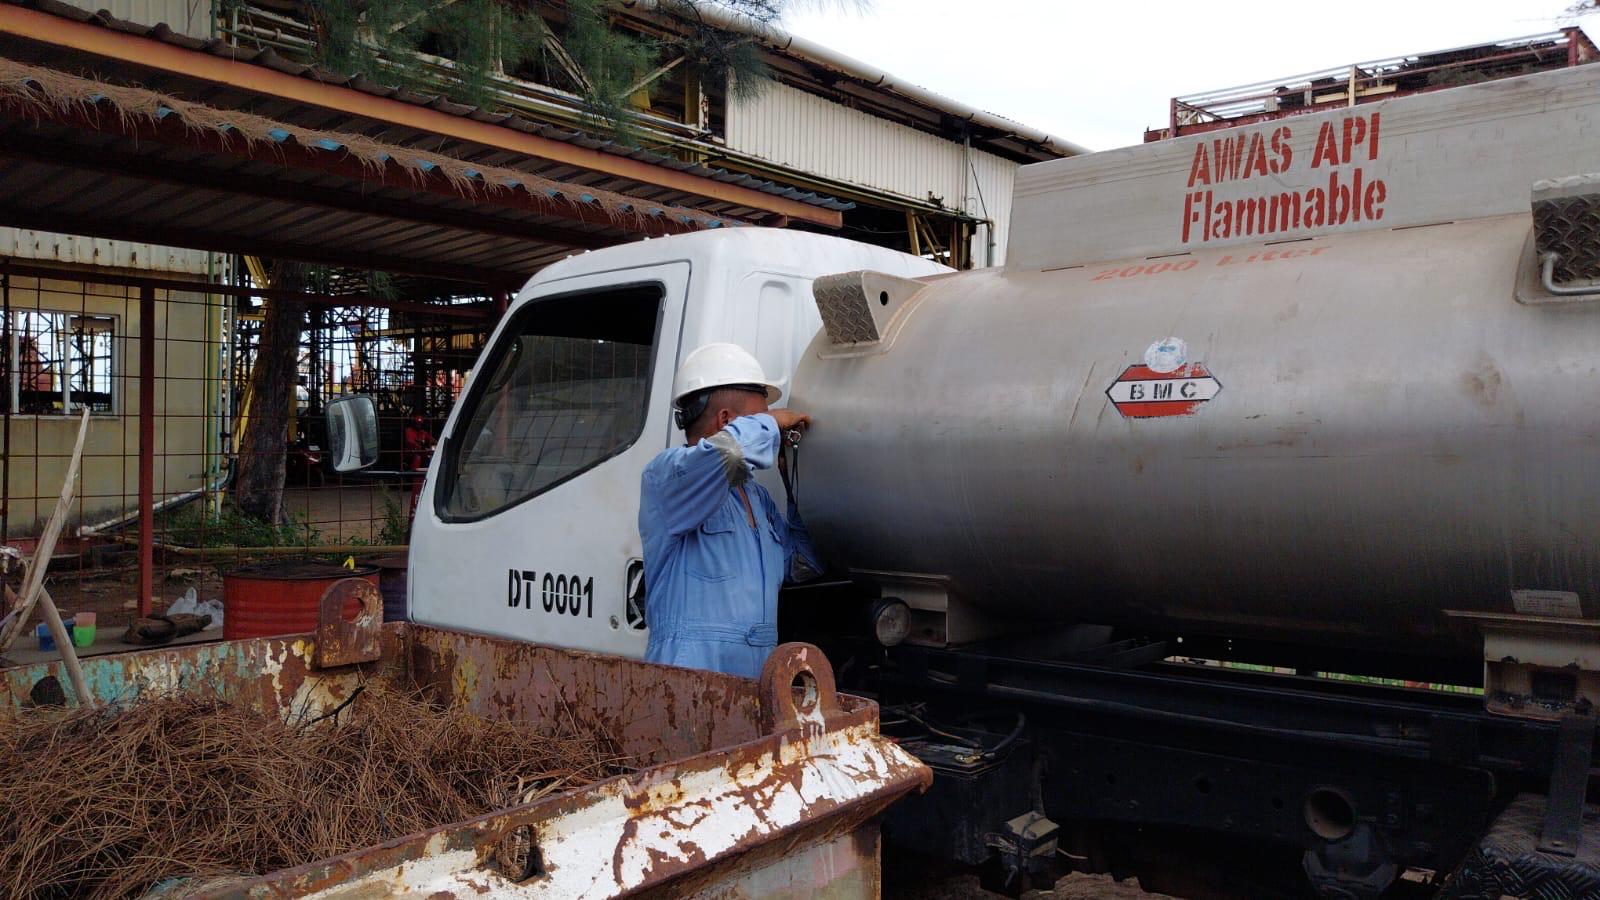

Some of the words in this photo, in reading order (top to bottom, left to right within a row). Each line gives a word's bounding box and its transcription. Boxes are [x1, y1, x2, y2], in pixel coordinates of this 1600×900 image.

[1187, 126, 1293, 188] AWAS
[1310, 112, 1380, 168] API
[1181, 168, 1386, 243] Flammable
[1090, 259, 1199, 281] 2000
[508, 569, 536, 609] DT
[542, 572, 593, 618] 0001
